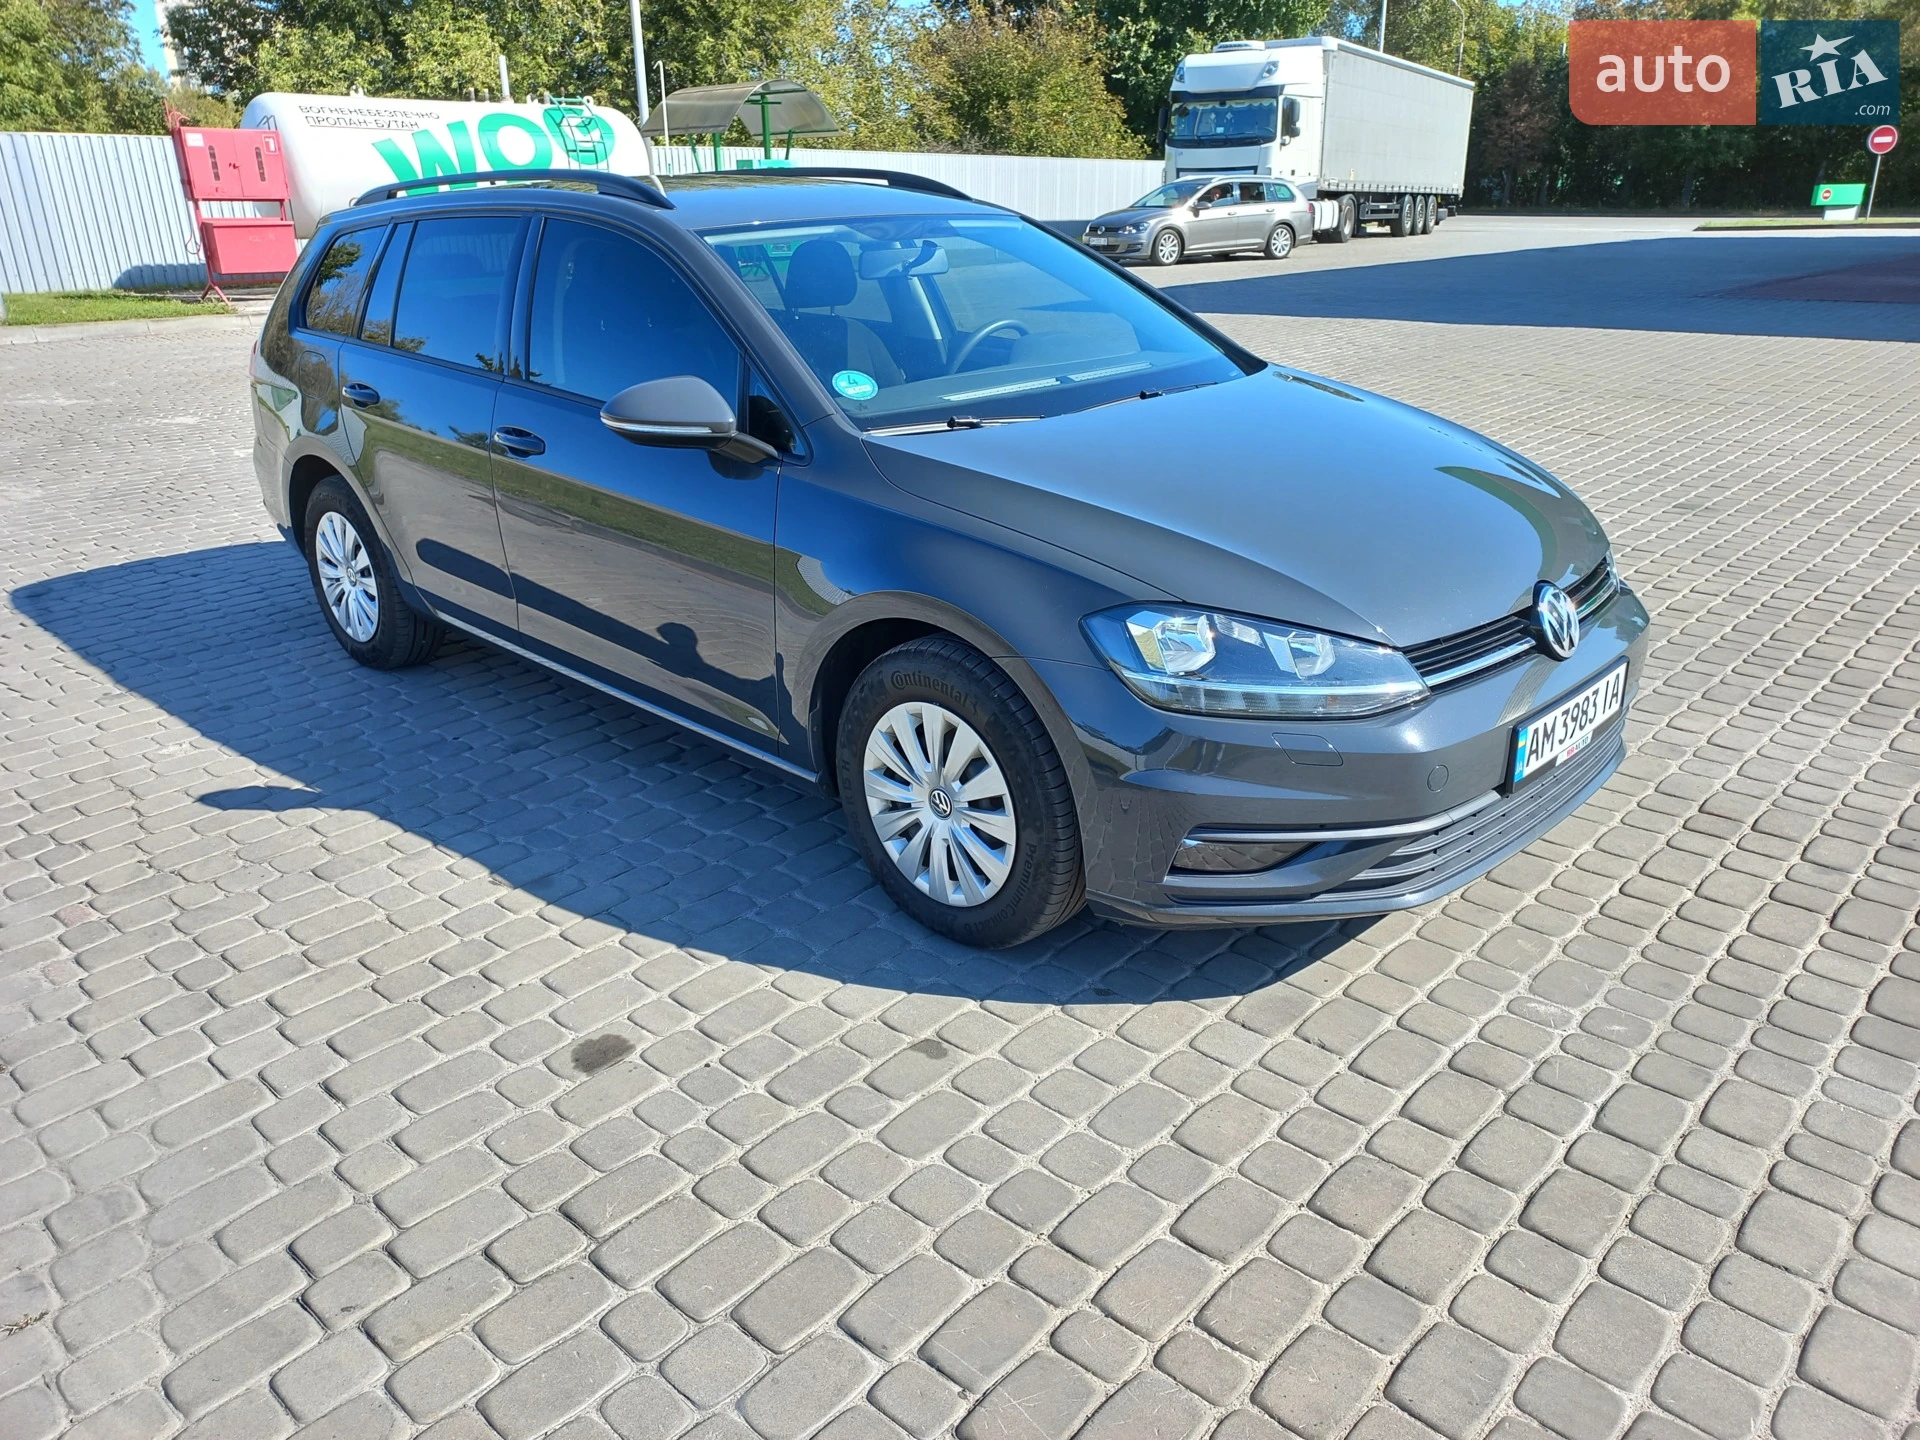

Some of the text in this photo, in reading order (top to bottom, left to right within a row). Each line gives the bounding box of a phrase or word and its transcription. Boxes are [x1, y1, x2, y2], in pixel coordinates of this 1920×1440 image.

[298, 104, 441, 121] ВОГНЕНЕБЕЗПЕЧНО
[304, 114, 420, 130] ПРОПАН-БУТАН
[371, 107, 616, 196] WOG
[890, 669, 970, 708] Continental
[1525, 672, 1621, 769] AM 3983 IA
